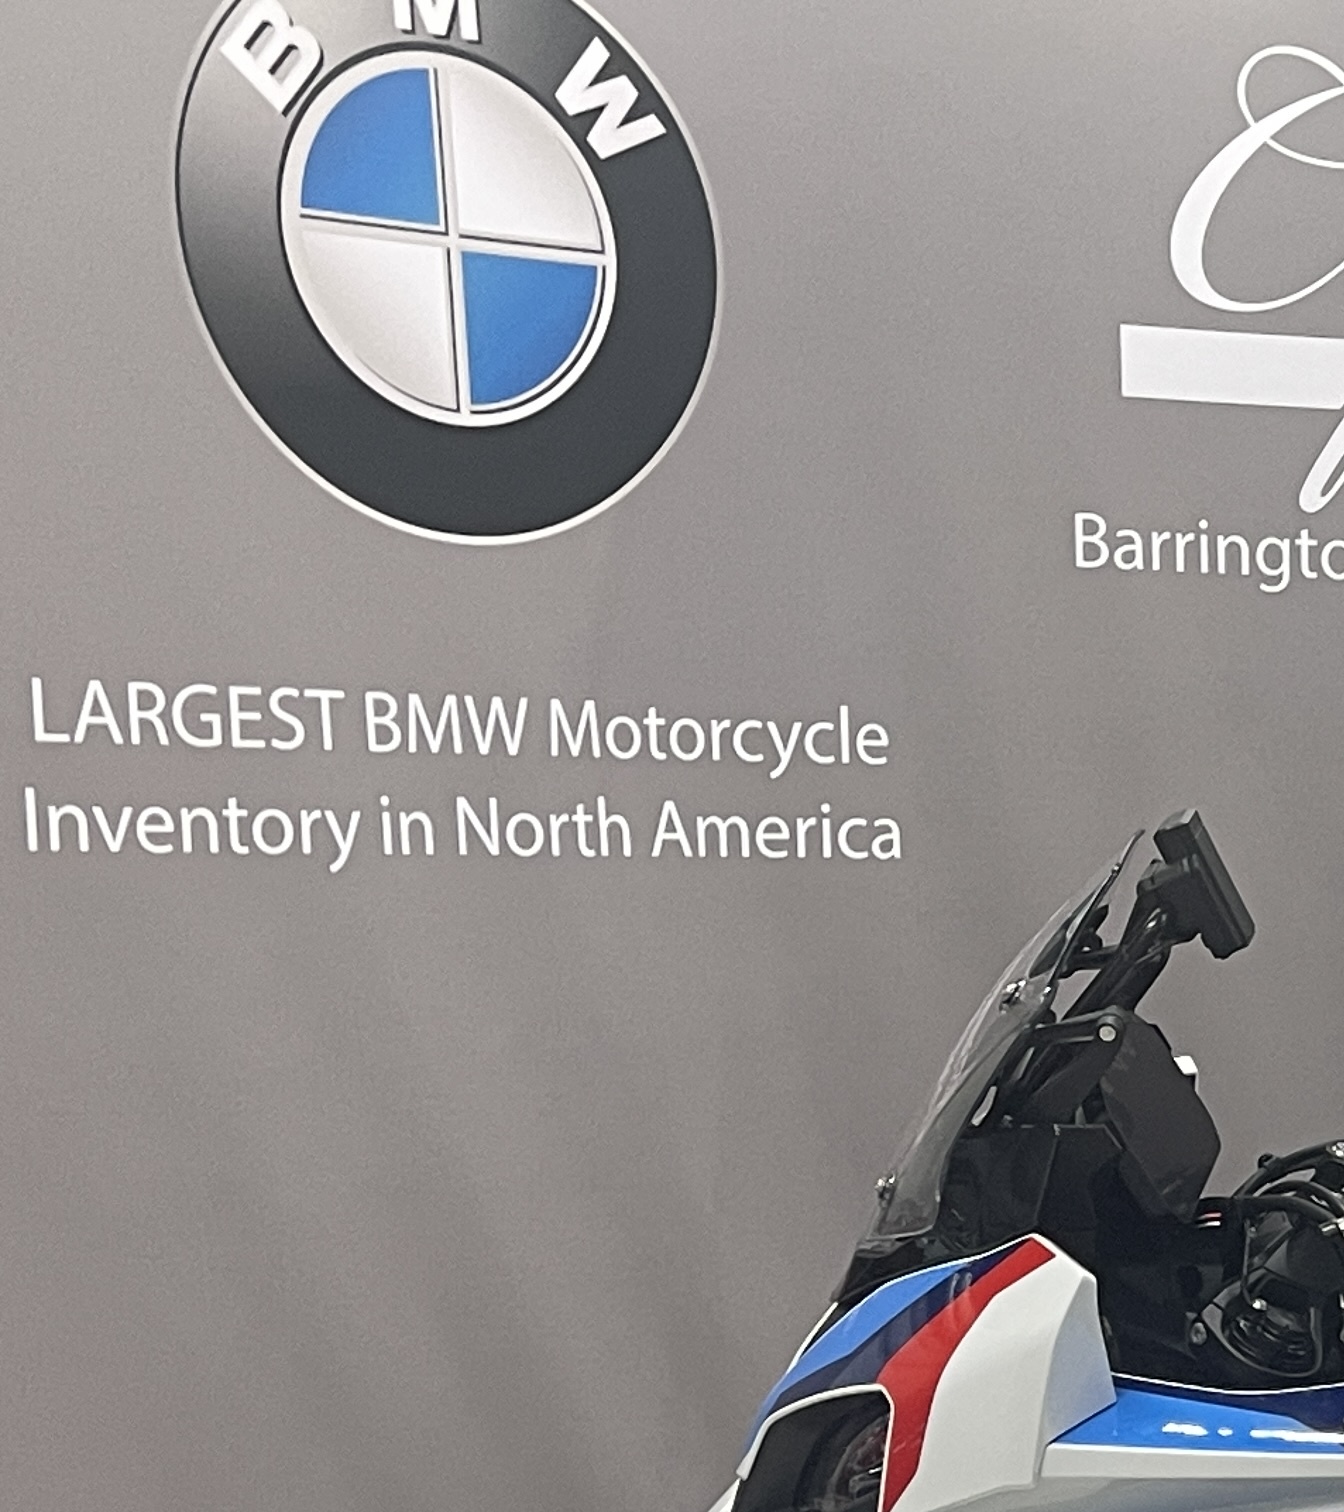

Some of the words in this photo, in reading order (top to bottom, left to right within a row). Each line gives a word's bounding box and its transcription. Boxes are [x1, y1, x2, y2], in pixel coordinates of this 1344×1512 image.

[30, 676, 346, 752] LARGEST
[363, 690, 529, 757] BMW
[549, 697, 890, 780] Motorcycle
[23, 786, 362, 874] Inventory
[379, 794, 435, 856] in
[455, 794, 633, 859] North
[650, 799, 902, 861] America
